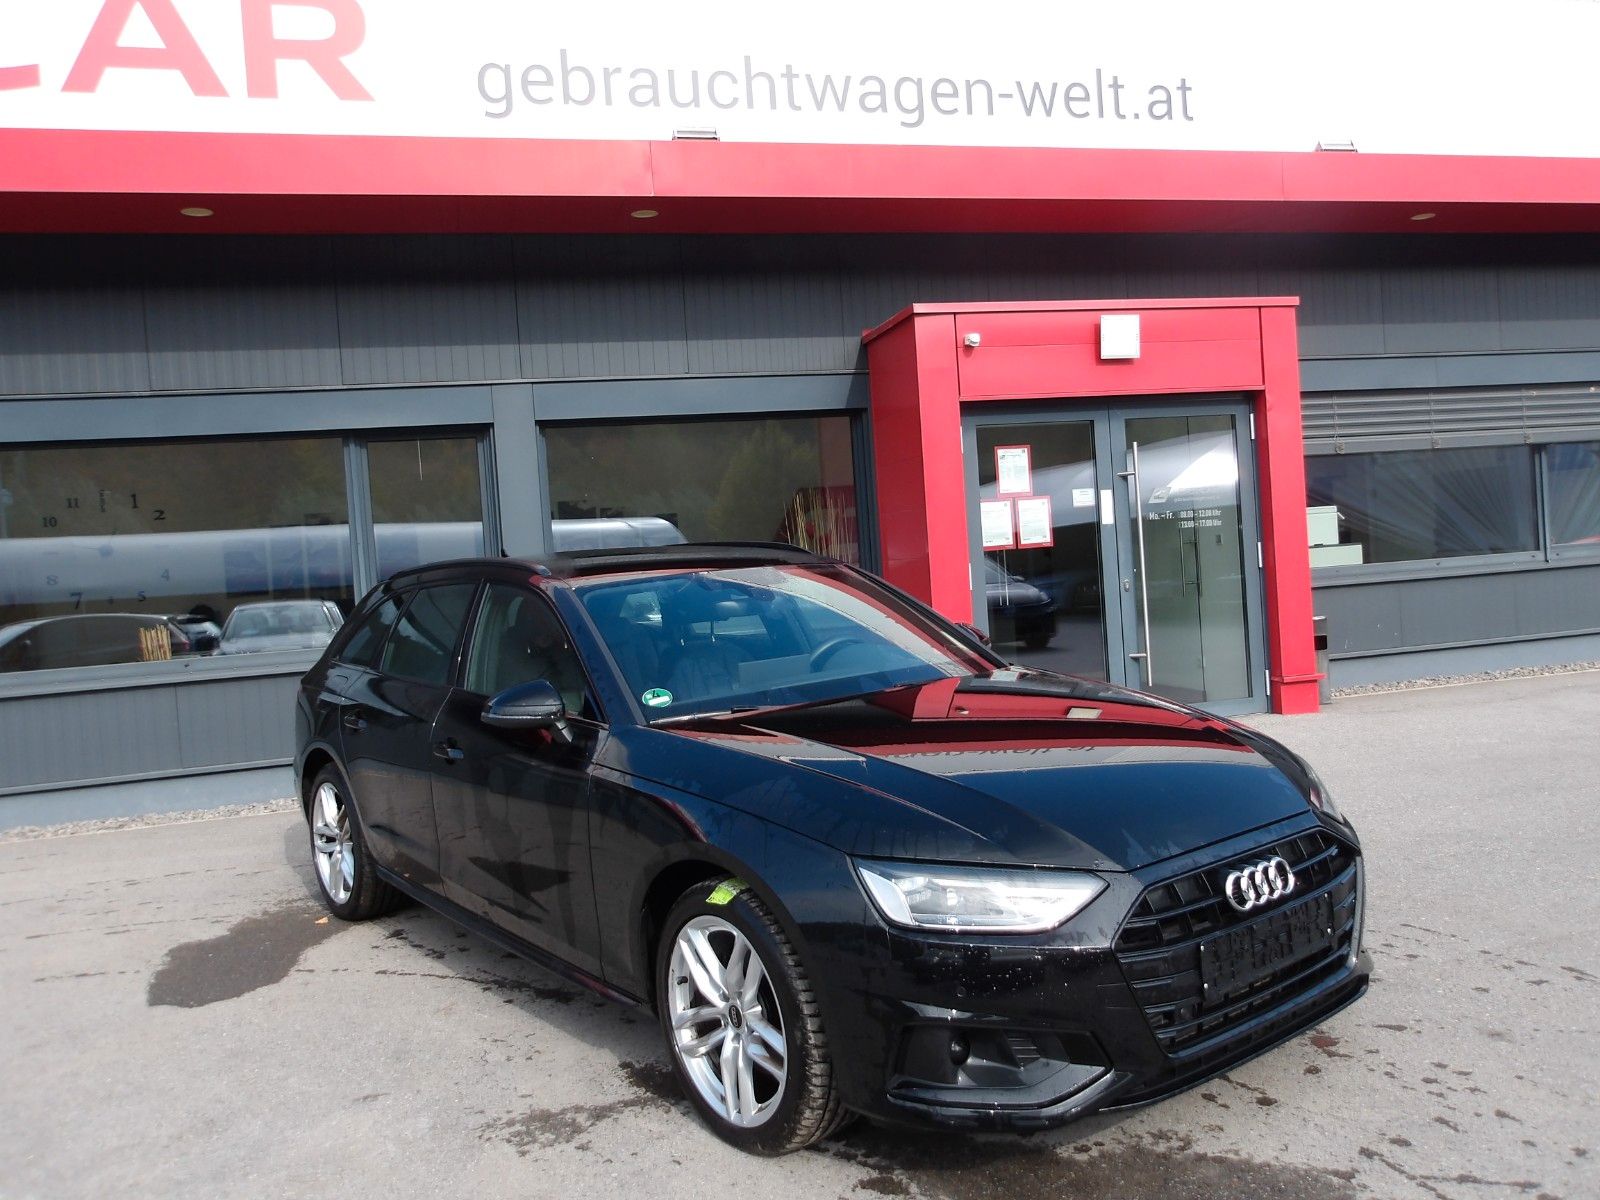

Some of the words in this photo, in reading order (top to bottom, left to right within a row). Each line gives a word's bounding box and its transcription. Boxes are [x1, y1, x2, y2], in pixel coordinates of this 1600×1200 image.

[0, 0, 374, 101] AR
[478, 49, 1193, 127] gebrauchtwagen-welt.at
[153, 510, 165, 521] 2
[69, 591, 83, 610] 7
